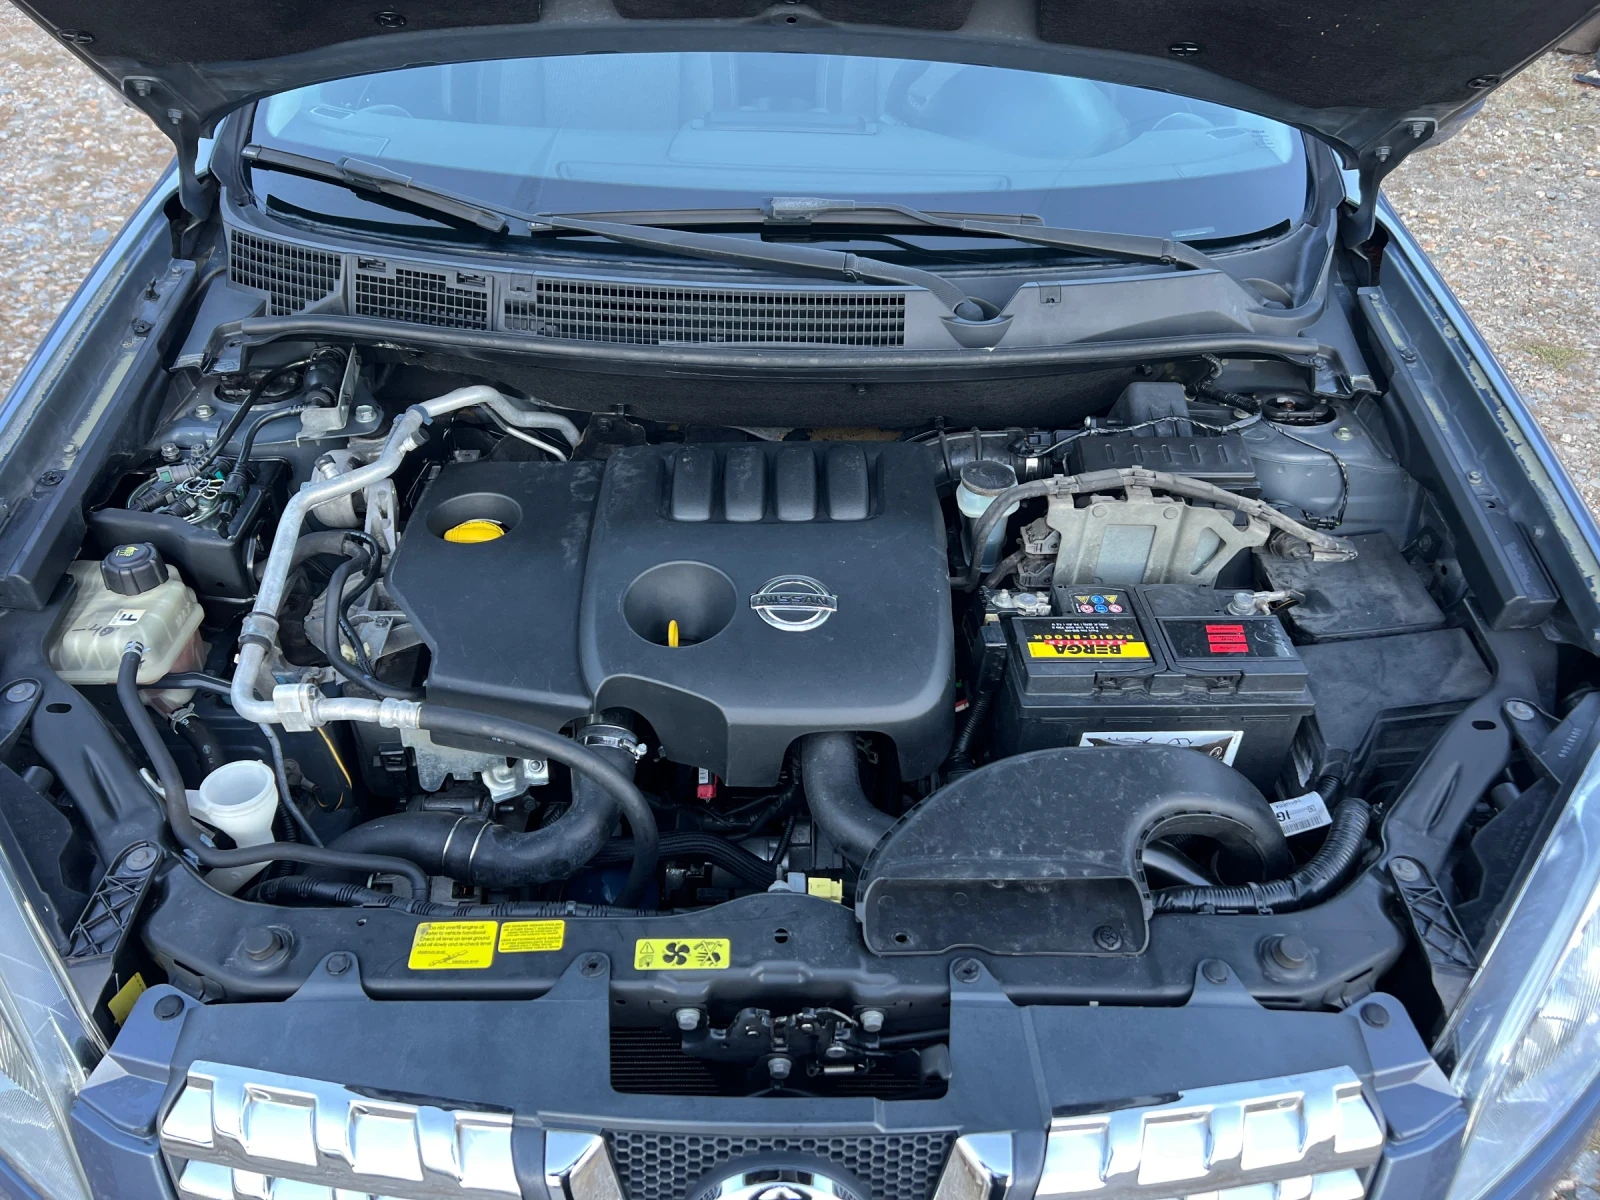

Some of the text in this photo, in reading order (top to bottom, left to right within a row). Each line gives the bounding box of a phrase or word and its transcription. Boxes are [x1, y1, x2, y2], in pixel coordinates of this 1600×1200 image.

[759, 594, 829, 606] NISSAN
[119, 613, 138, 622] F
[1052, 644, 1122, 654] BERGA
